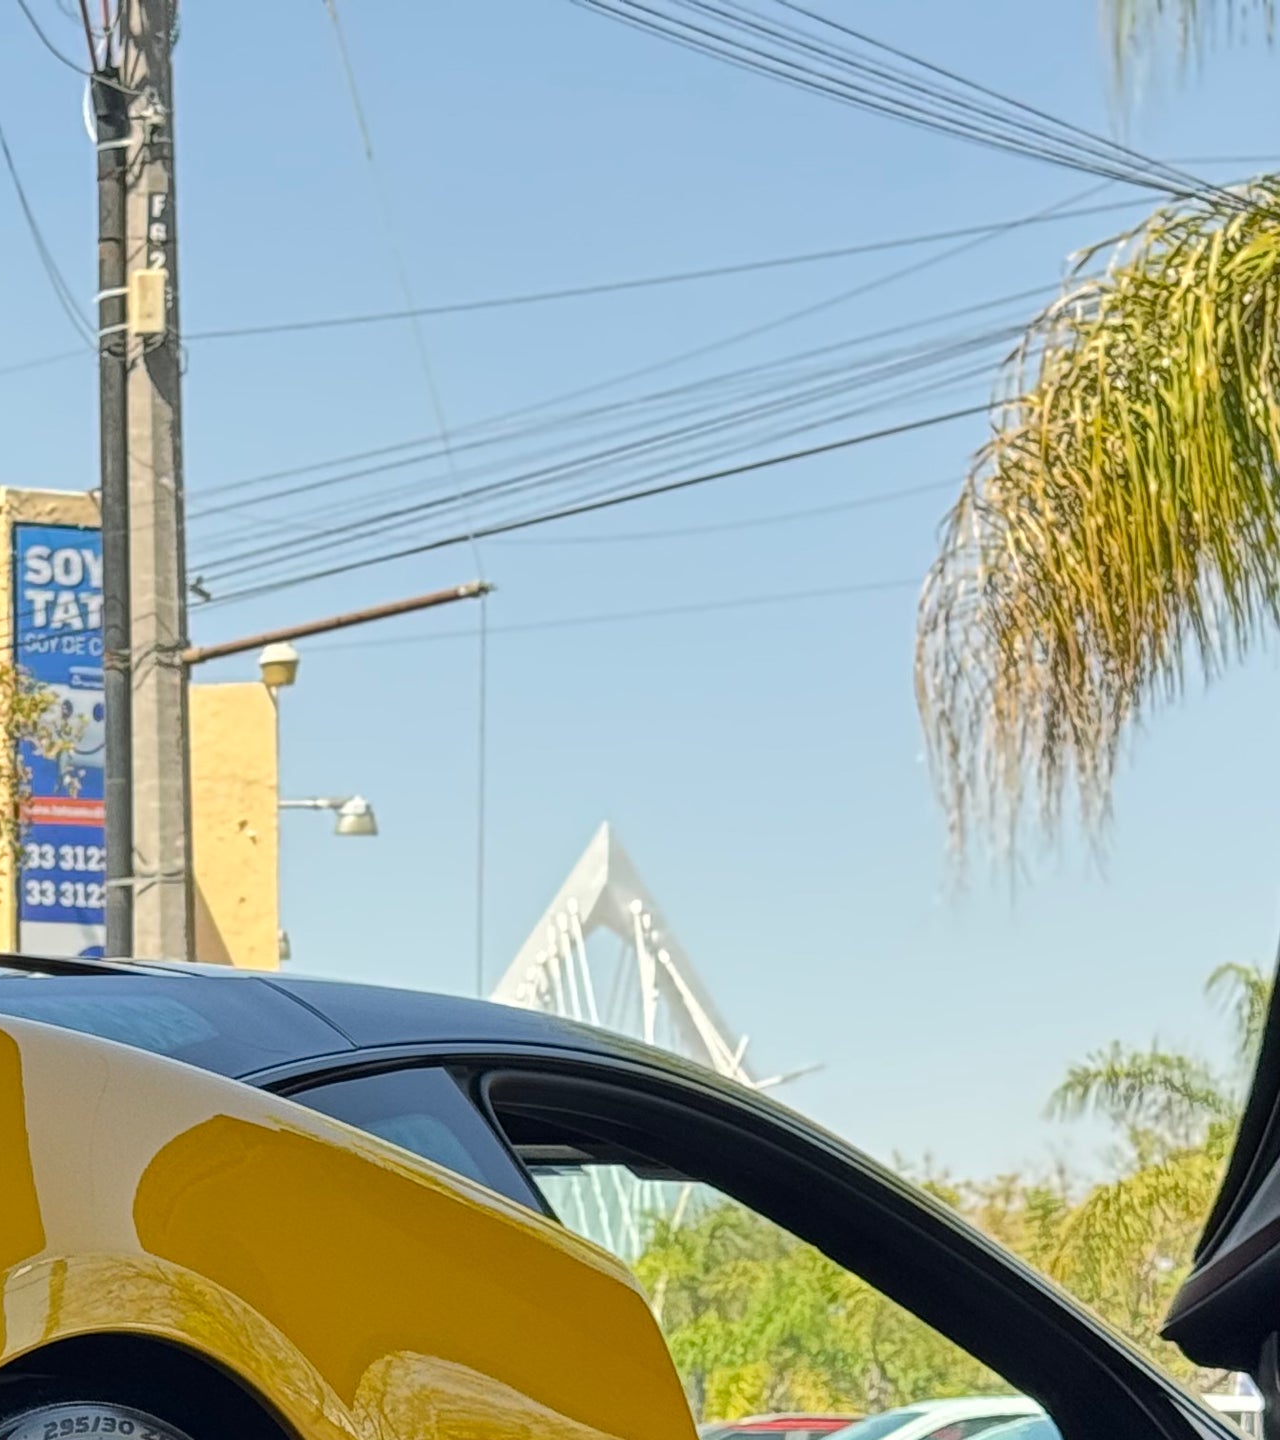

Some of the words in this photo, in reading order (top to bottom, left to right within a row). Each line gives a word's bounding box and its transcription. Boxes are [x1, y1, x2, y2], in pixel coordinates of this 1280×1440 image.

[24, 544, 103, 588] SOY
[24, 632, 59, 654] SOY
[62, 636, 86, 655] DE
[25, 843, 56, 871] 33
[25, 879, 56, 907] 33
